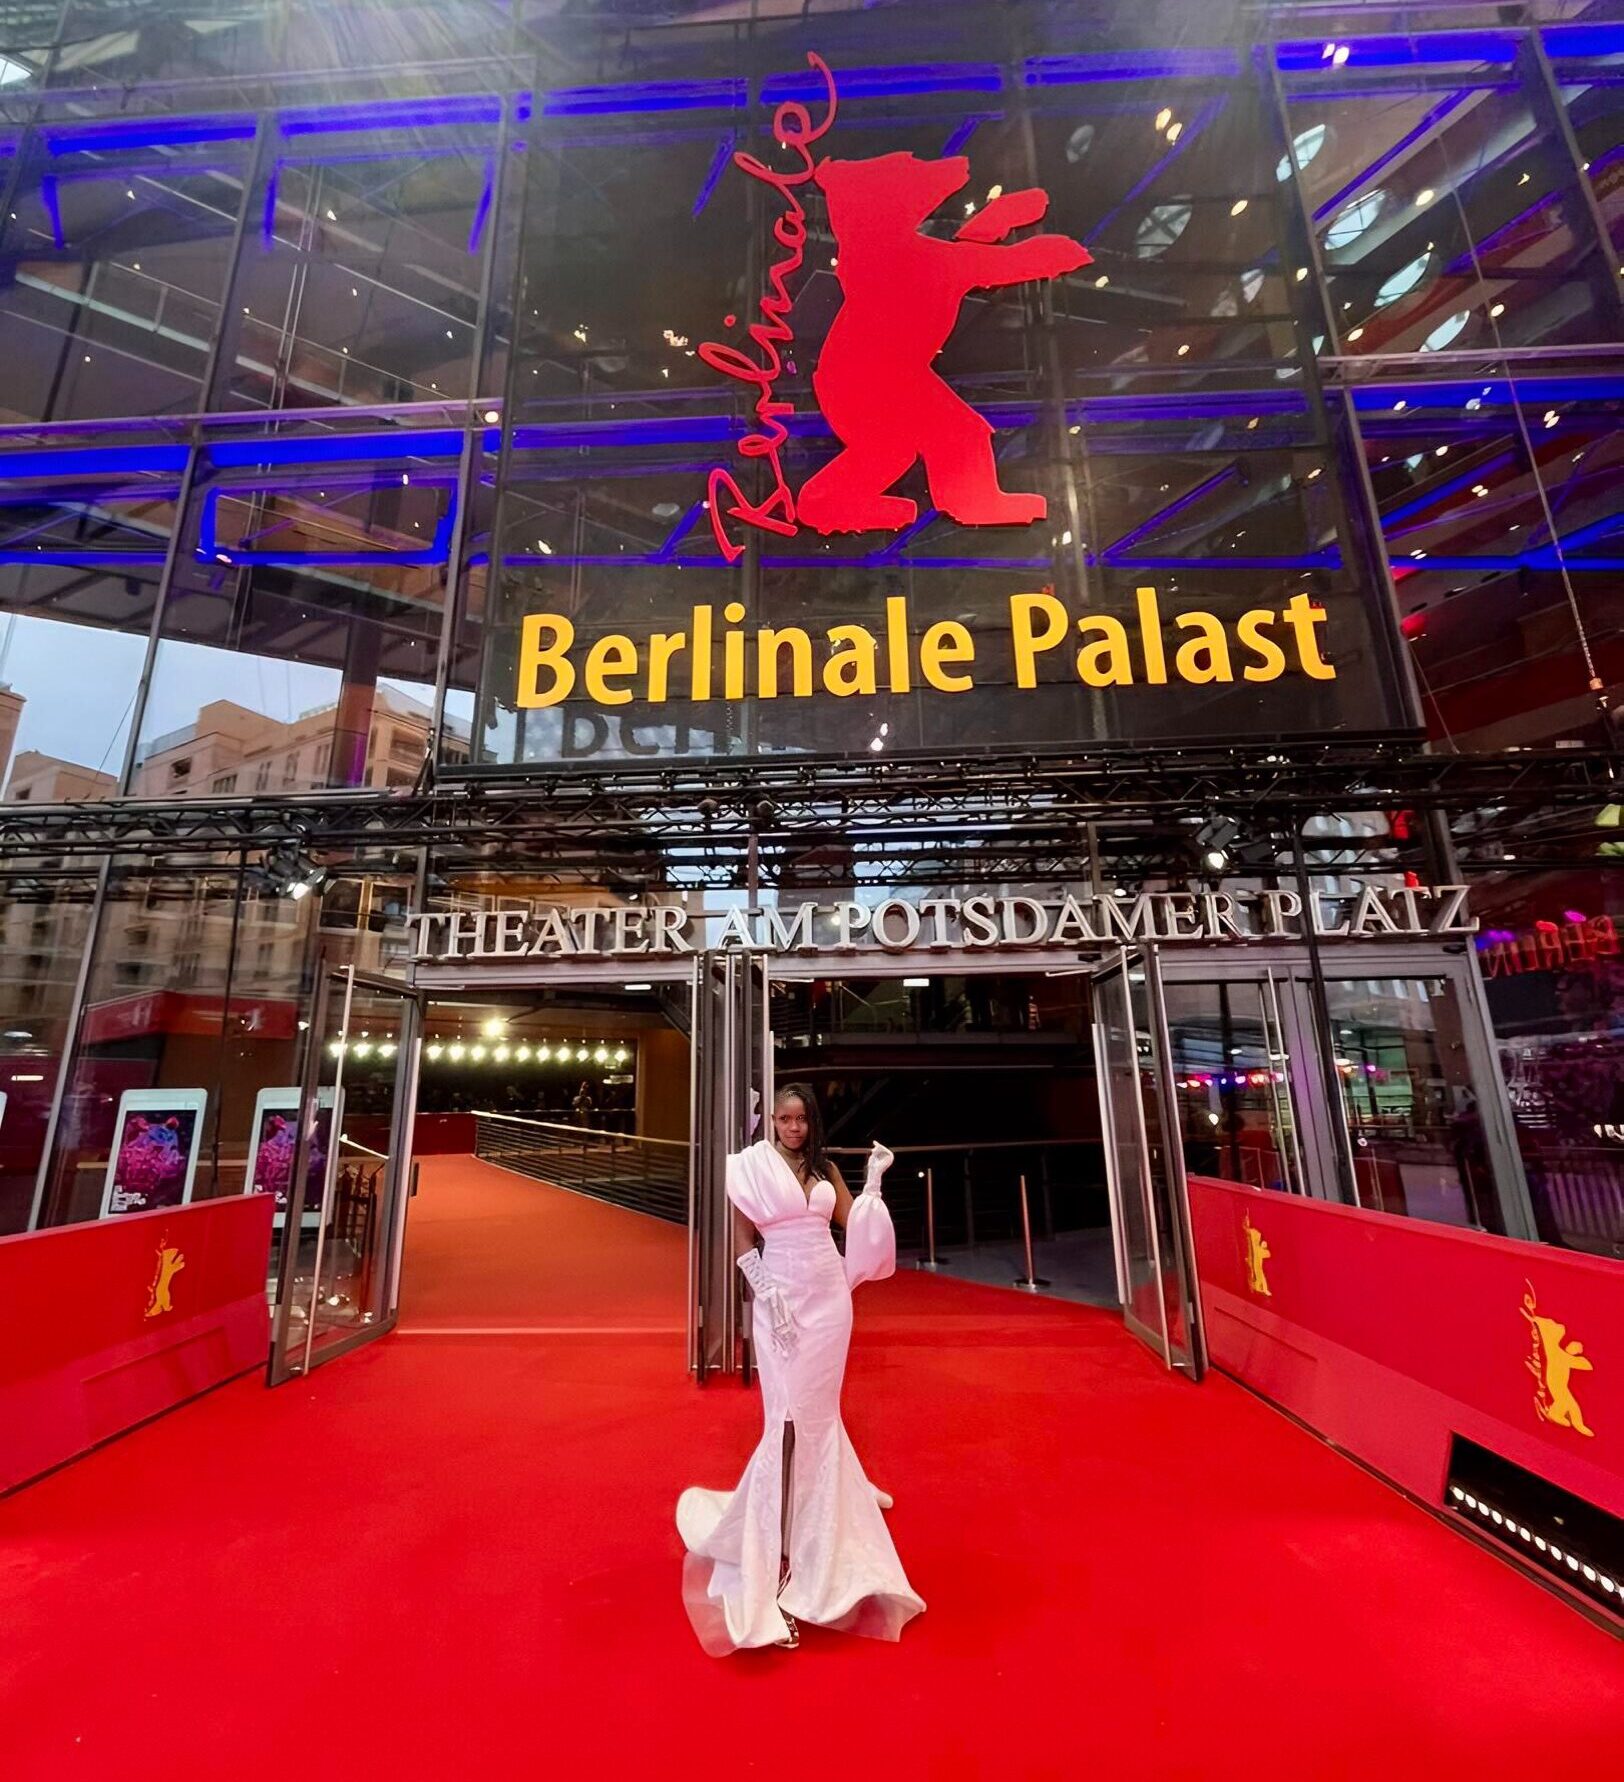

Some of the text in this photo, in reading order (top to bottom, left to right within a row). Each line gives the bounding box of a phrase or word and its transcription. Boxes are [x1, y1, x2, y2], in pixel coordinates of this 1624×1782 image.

[698, 51, 838, 563] Berlinale
[515, 587, 1336, 708] Berlinale Palast
[406, 884, 1480, 960] THEATER AM POTSDAMER PLATZ
